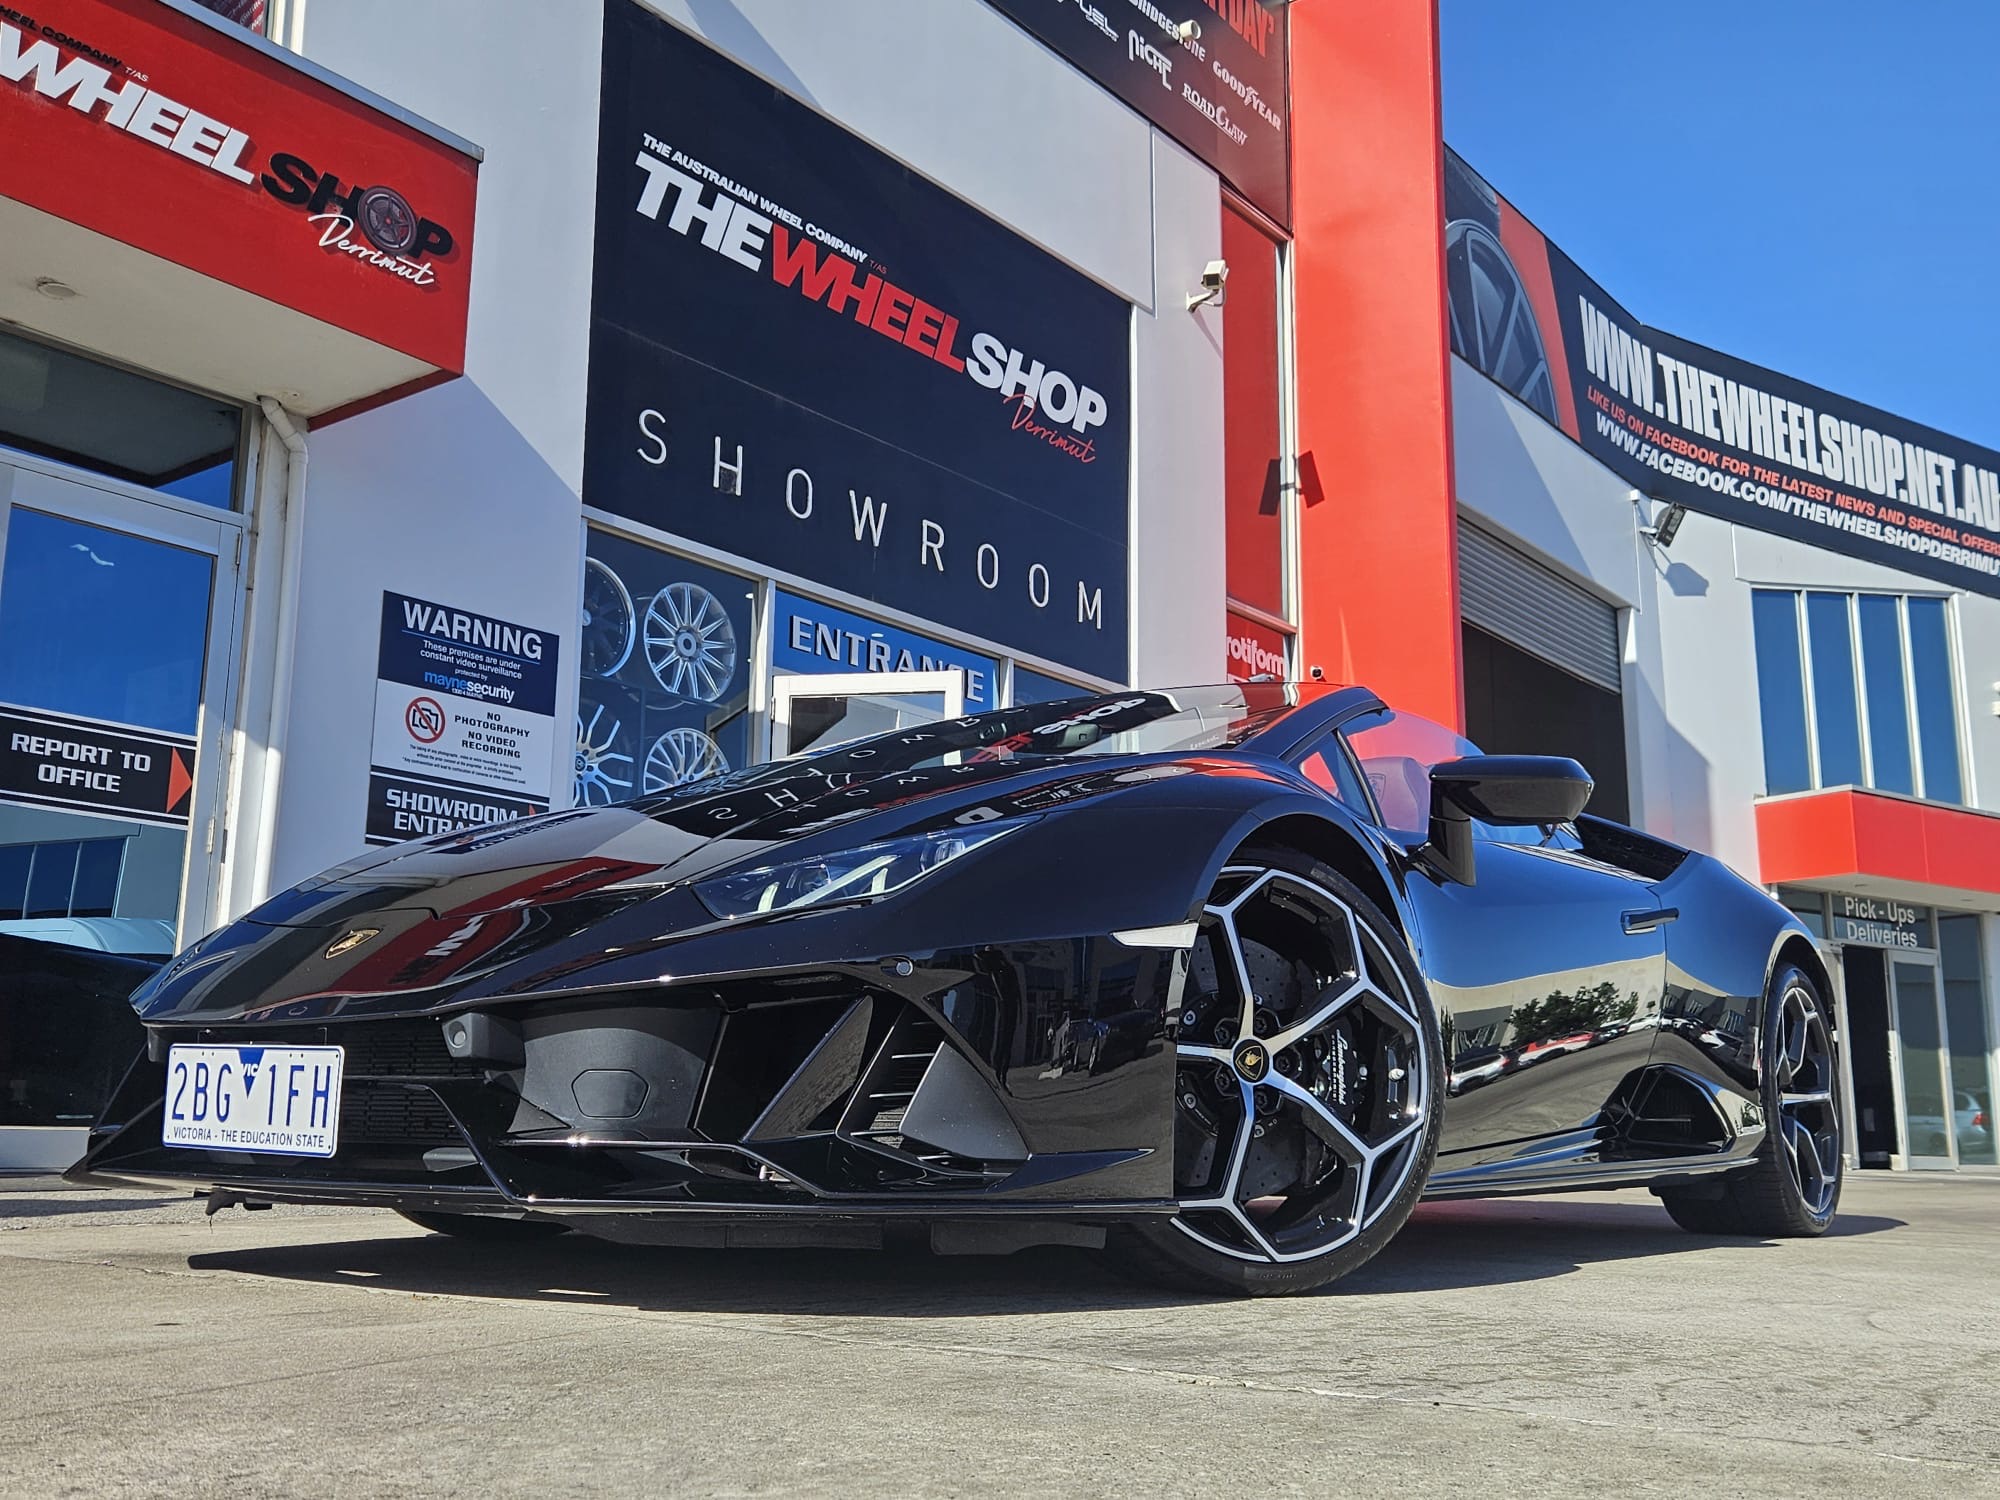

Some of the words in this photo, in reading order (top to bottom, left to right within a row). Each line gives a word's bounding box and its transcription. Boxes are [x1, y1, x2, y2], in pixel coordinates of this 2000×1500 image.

[1075, 0, 1119, 39] UEL
[42, 26, 122, 68] COMPANY
[125, 66, 149, 82] T/AS
[0, 21, 255, 185] WHEEL
[643, 132, 672, 160] THE
[671, 149, 759, 205] AUSTRALIAN
[759, 195, 804, 231] WHEEL
[804, 222, 868, 264] COMPANY
[965, 331, 1108, 434] SHOP
[1578, 293, 2000, 533] WWW.THEWHEELSHOP.NET.AU
[1586, 384, 1610, 413] LIKE
[1610, 402, 1626, 423] US
[1627, 414, 1645, 435] ON
[1645, 425, 1720, 467] FACEBOOK
[1720, 455, 1751, 478] FOR
[1752, 465, 1780, 487] THE
[1781, 475, 1834, 503] LATEST
[1835, 493, 1876, 518] NEWS
[1877, 506, 1906, 526] AND
[1907, 515, 1960, 544] SPECIAL
[1595, 411, 2000, 578] WWW.FACEBOOK.COM/THEWHEELSHOPDERRIMU
[636, 408, 1104, 632] SHOWROOM
[402, 600, 542, 661] WARNING
[420, 649, 454, 664] constant
[455, 656, 477, 669] video
[478, 664, 523, 680] surveillance
[423, 639, 448, 654] These
[448, 646, 484, 663] premises
[485, 656, 498, 666] are
[499, 658, 521, 671] under
[454, 715, 531, 738] PHOTOGRAPHY
[486, 711, 501, 722] NO
[11, 732, 113, 766] REPORT
[120, 750, 151, 772] TO
[461, 739, 521, 759] RECORDING
[468, 730, 483, 741] NO
[486, 734, 516, 748] VIDEO
[37, 763, 121, 793] OFFICE
[386, 788, 519, 824] SHOWROOM
[1844, 896, 1877, 919] Pick
[1886, 902, 1915, 926] Ups
[1847, 920, 1918, 948] Deliveries
[241, 1063, 260, 1078] VIC
[171, 1062, 232, 1123] 2BG
[267, 1064, 332, 1129] 1FH
[173, 1126, 212, 1142] VICTORIA
[220, 1129, 238, 1144] THE
[240, 1130, 293, 1146] EDUCATION
[295, 1133, 325, 1148] STATE
